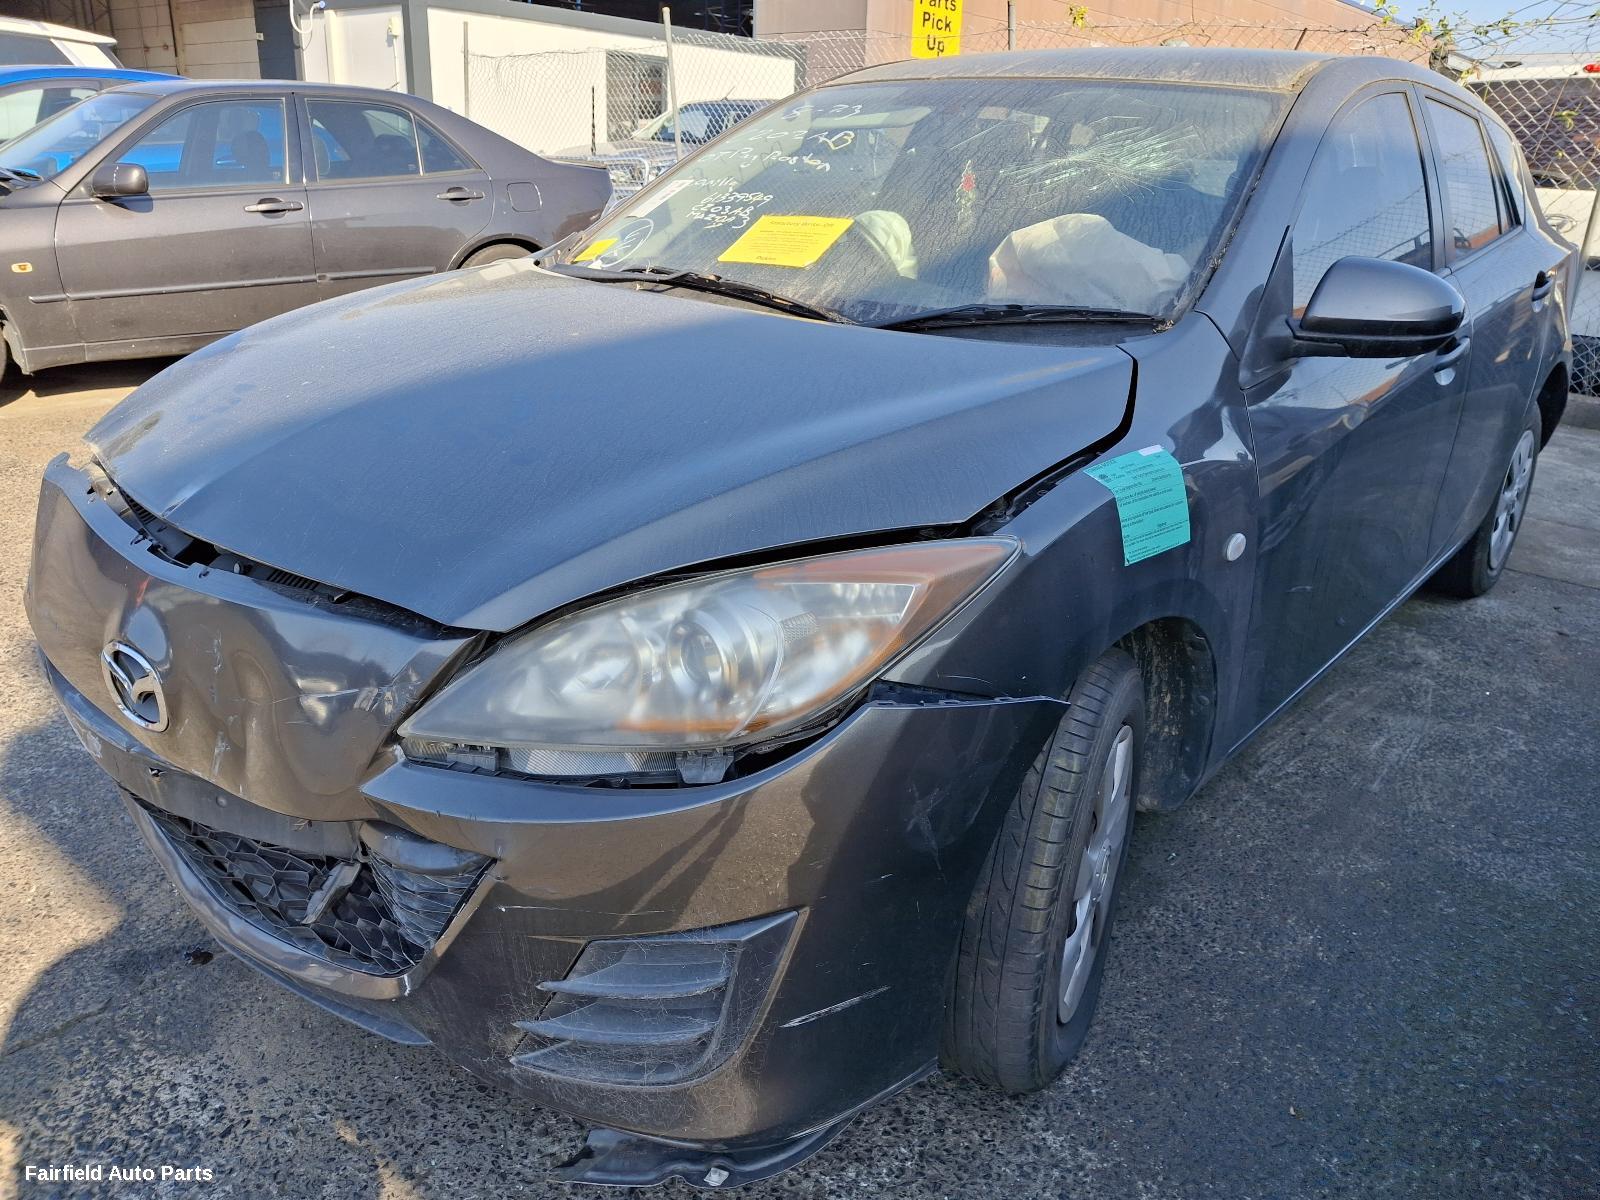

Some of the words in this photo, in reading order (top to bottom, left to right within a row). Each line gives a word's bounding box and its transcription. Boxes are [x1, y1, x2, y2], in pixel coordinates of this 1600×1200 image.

[920, 0, 957, 11] arts
[922, 11, 952, 32] Pick
[927, 34, 945, 57] Up
